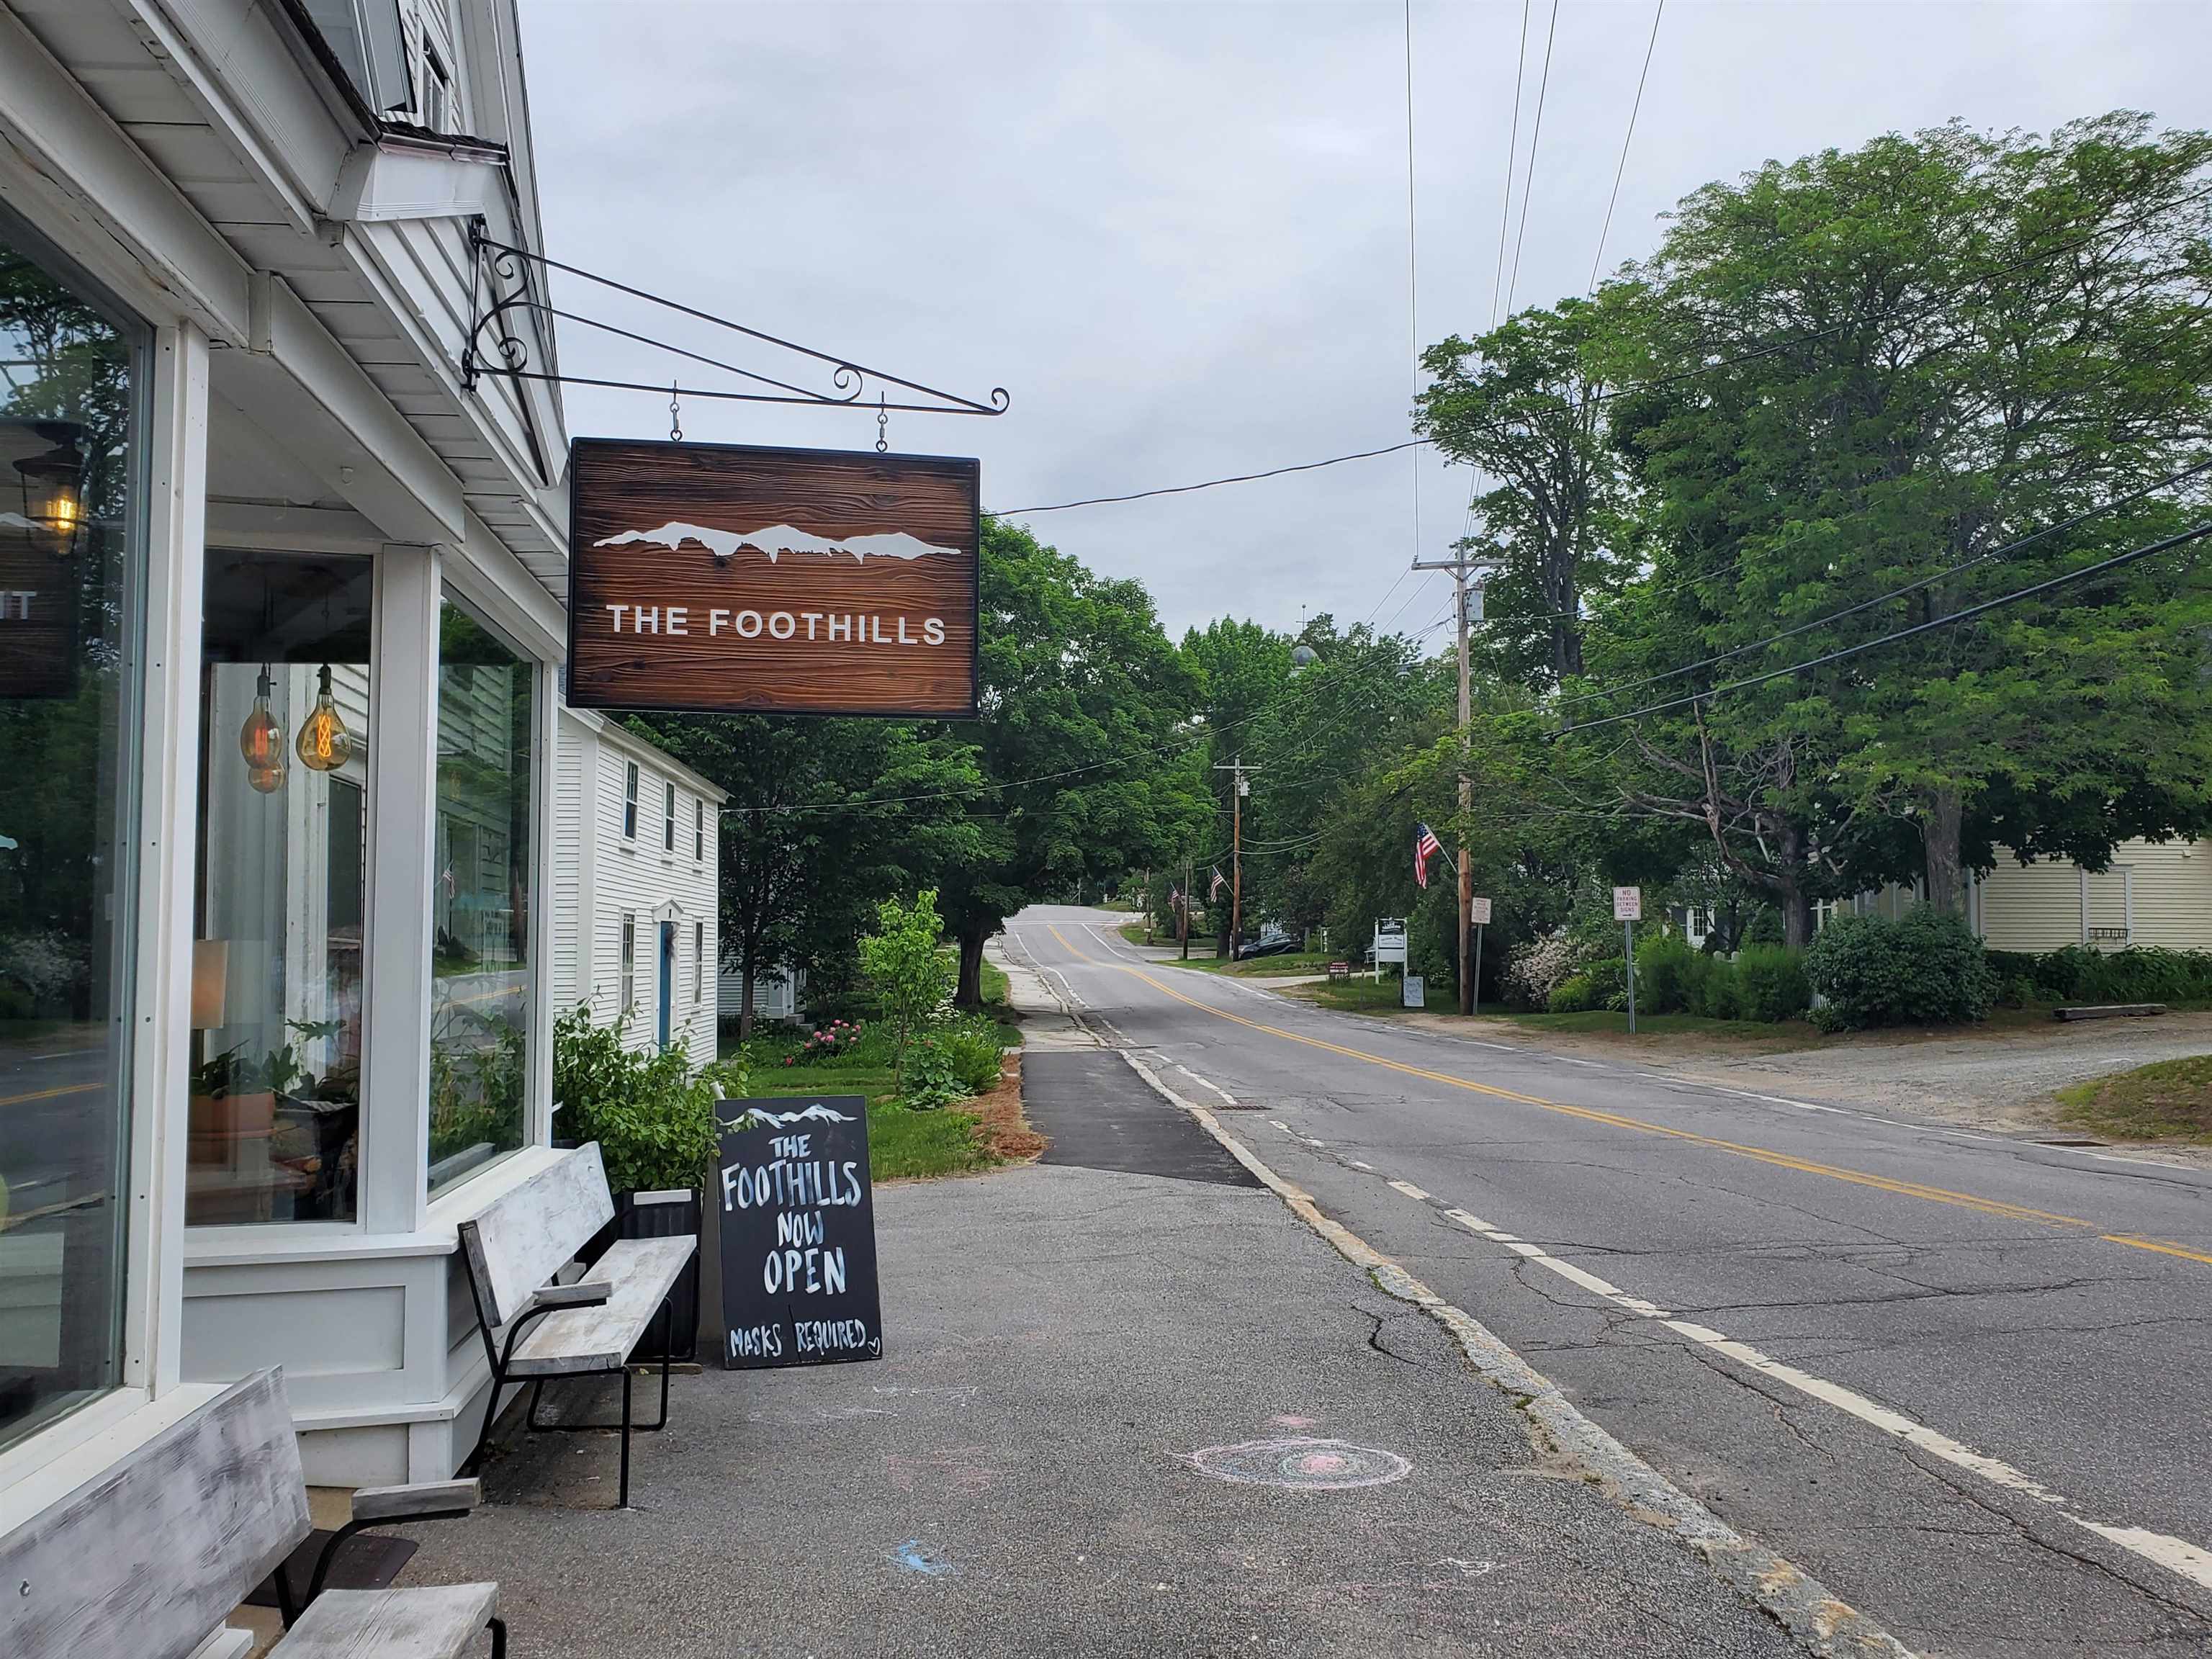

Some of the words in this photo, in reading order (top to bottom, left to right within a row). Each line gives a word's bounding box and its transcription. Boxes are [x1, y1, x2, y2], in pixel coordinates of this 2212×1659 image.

[606, 605, 688, 636] THE
[709, 608, 946, 647] FOOTHILLS
[768, 1134, 812, 1158] THE
[721, 1160, 862, 1210] FOOTHILLS
[778, 1210, 823, 1247] NOW
[764, 1246, 846, 1295] OPEN
[730, 1323, 783, 1358] MASKS
[795, 1318, 866, 1356] REQUIRED
